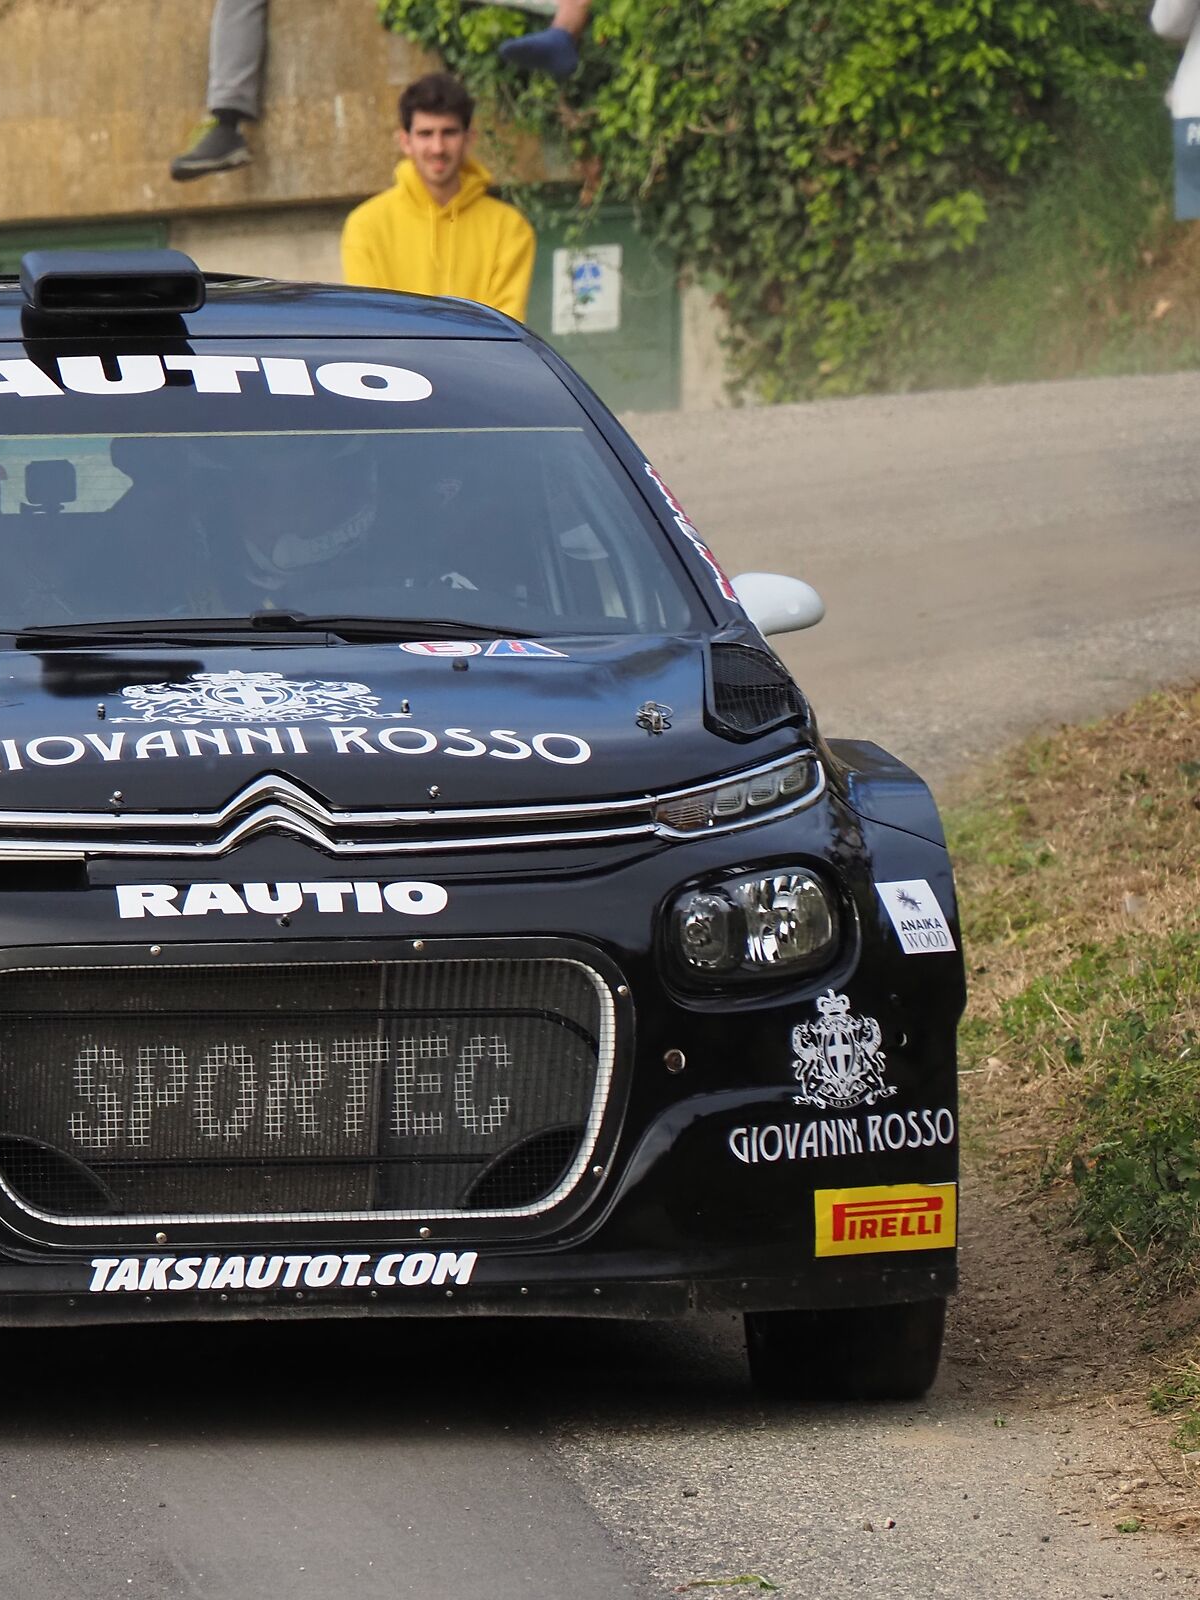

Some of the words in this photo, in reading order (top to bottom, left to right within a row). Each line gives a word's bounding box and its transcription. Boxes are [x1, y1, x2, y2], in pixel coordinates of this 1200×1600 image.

[332, 727, 591, 766] ROSSO
[116, 881, 448, 919] RAUTIO
[900, 918, 943, 932] ANAIKA
[904, 931, 948, 950] WOOD
[68, 1033, 512, 1149] SPORTEC
[729, 1117, 864, 1163] GIOVANNI
[868, 1107, 955, 1152] ROSSO
[832, 1196, 944, 1242] PIRELLI
[90, 1252, 478, 1292] TAKSIAUTOT.COM
